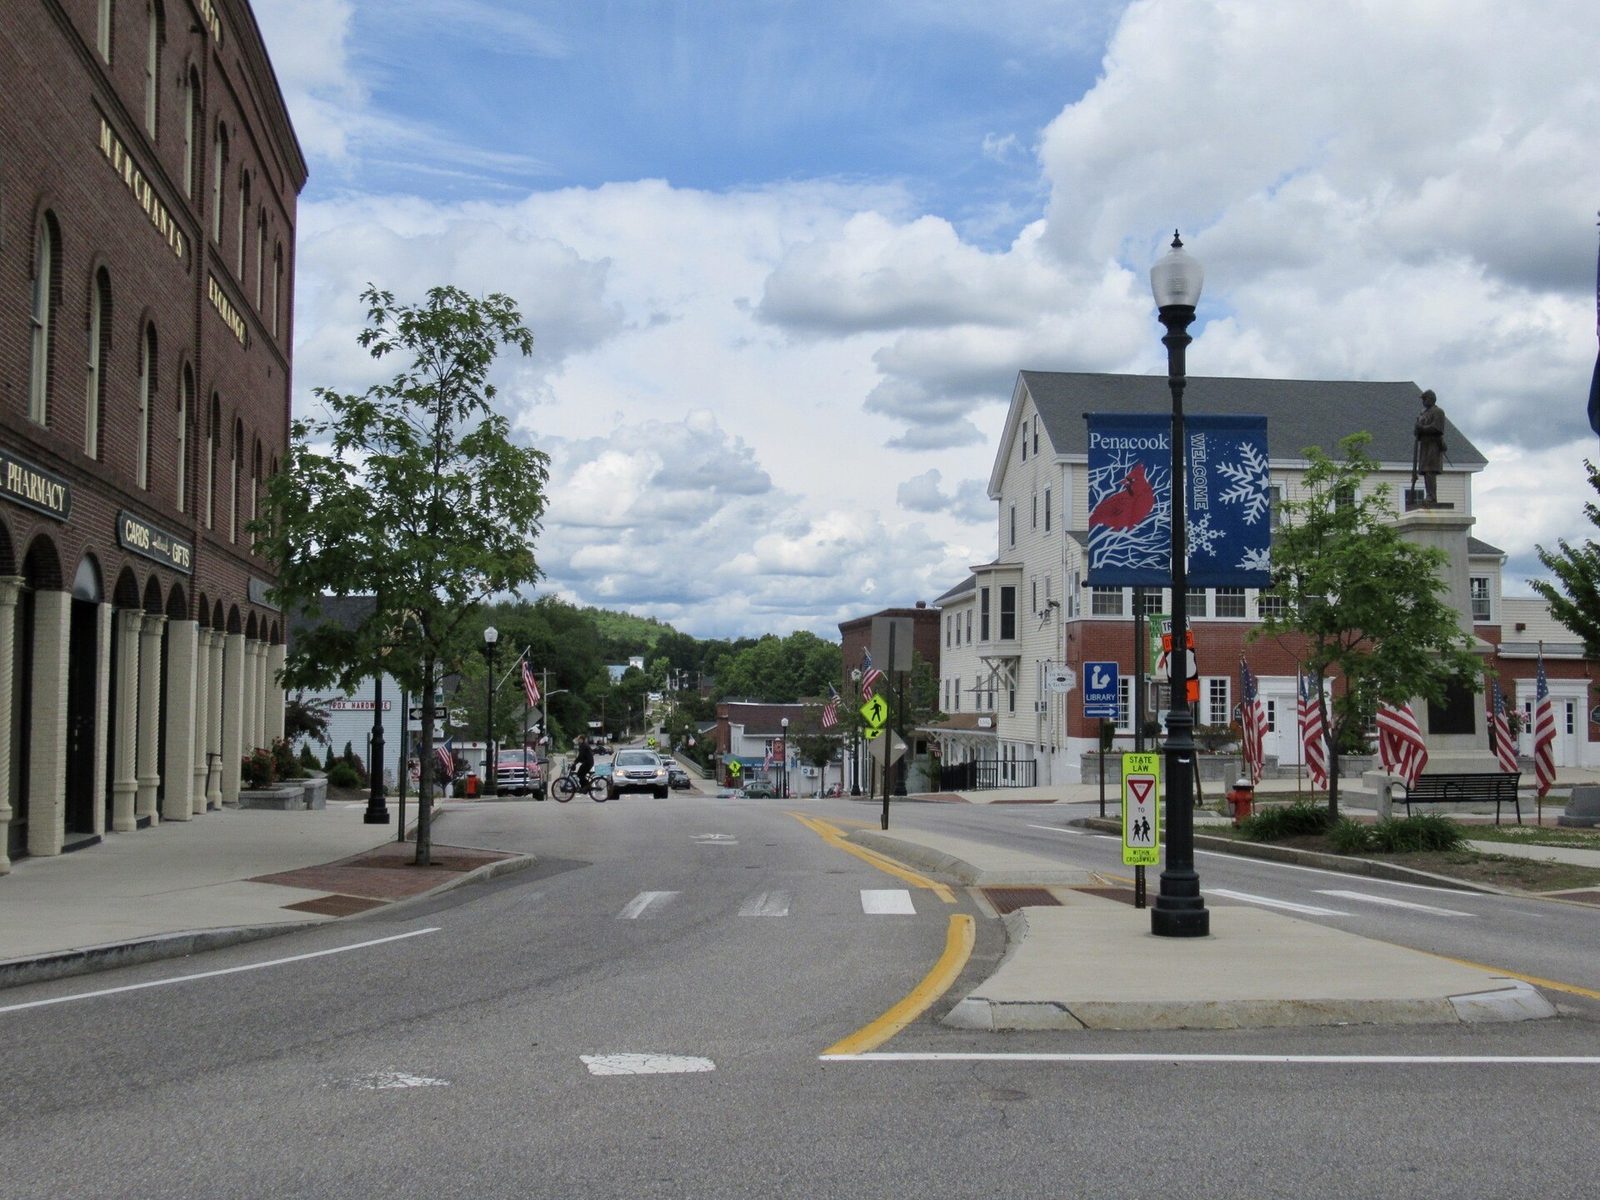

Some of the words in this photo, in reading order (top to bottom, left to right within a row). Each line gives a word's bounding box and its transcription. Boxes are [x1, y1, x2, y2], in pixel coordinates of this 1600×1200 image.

[1089, 432, 1170, 450] Penacook
[6, 461, 66, 512] PHARMACY
[1190, 432, 1209, 510] WELCOME
[125, 519, 150, 550] CARDS
[172, 543, 190, 568] GIFTS
[1086, 693, 1116, 701] LIBRARY
[1129, 756, 1153, 764] STATE
